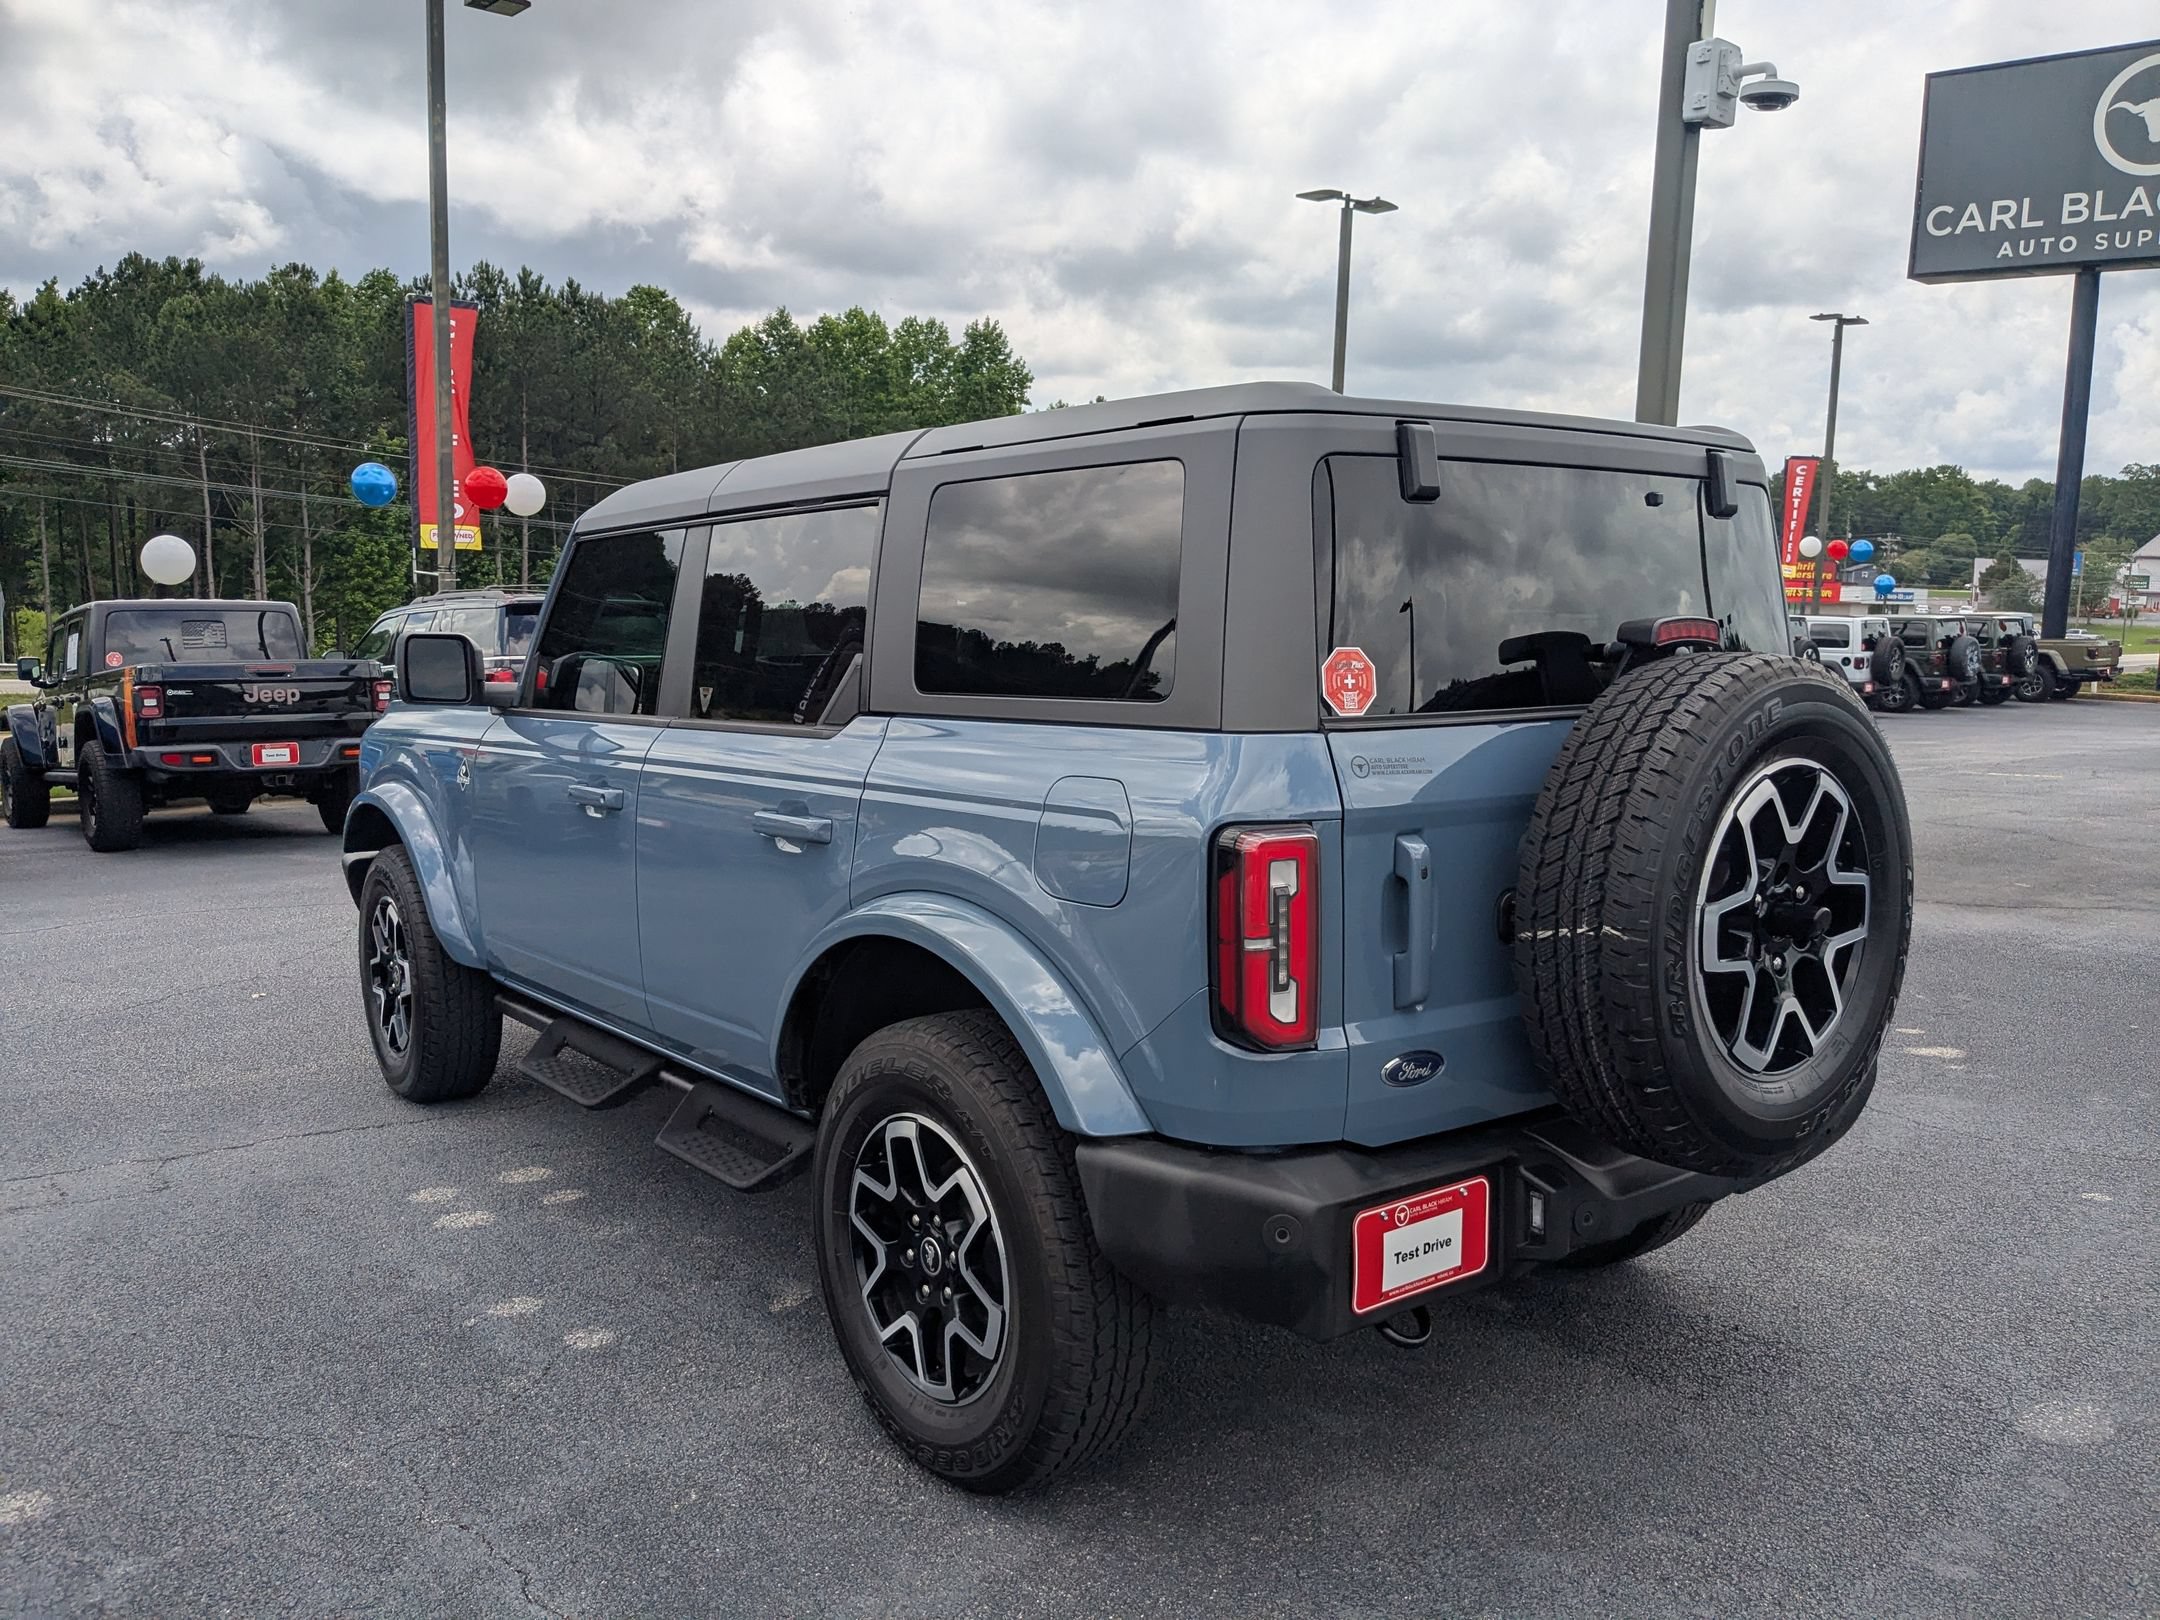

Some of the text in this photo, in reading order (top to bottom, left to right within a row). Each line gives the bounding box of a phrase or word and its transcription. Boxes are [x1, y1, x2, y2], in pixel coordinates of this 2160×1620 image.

[1926, 186, 2160, 237] CARL BLA
[1996, 229, 2160, 258] AUTO SUP
[1786, 465, 1808, 563] CERTIFIED
[243, 685, 300, 705] Jeep
[1667, 697, 1784, 1039] BRIDGESTONE
[1398, 1061, 1432, 1081] Ford
[831, 1057, 953, 1120] DUELER
[1410, 1205, 1422, 1213] CARL
[1422, 1201, 1438, 1210] BLACK
[1394, 1238, 1452, 1265] Test Drive
